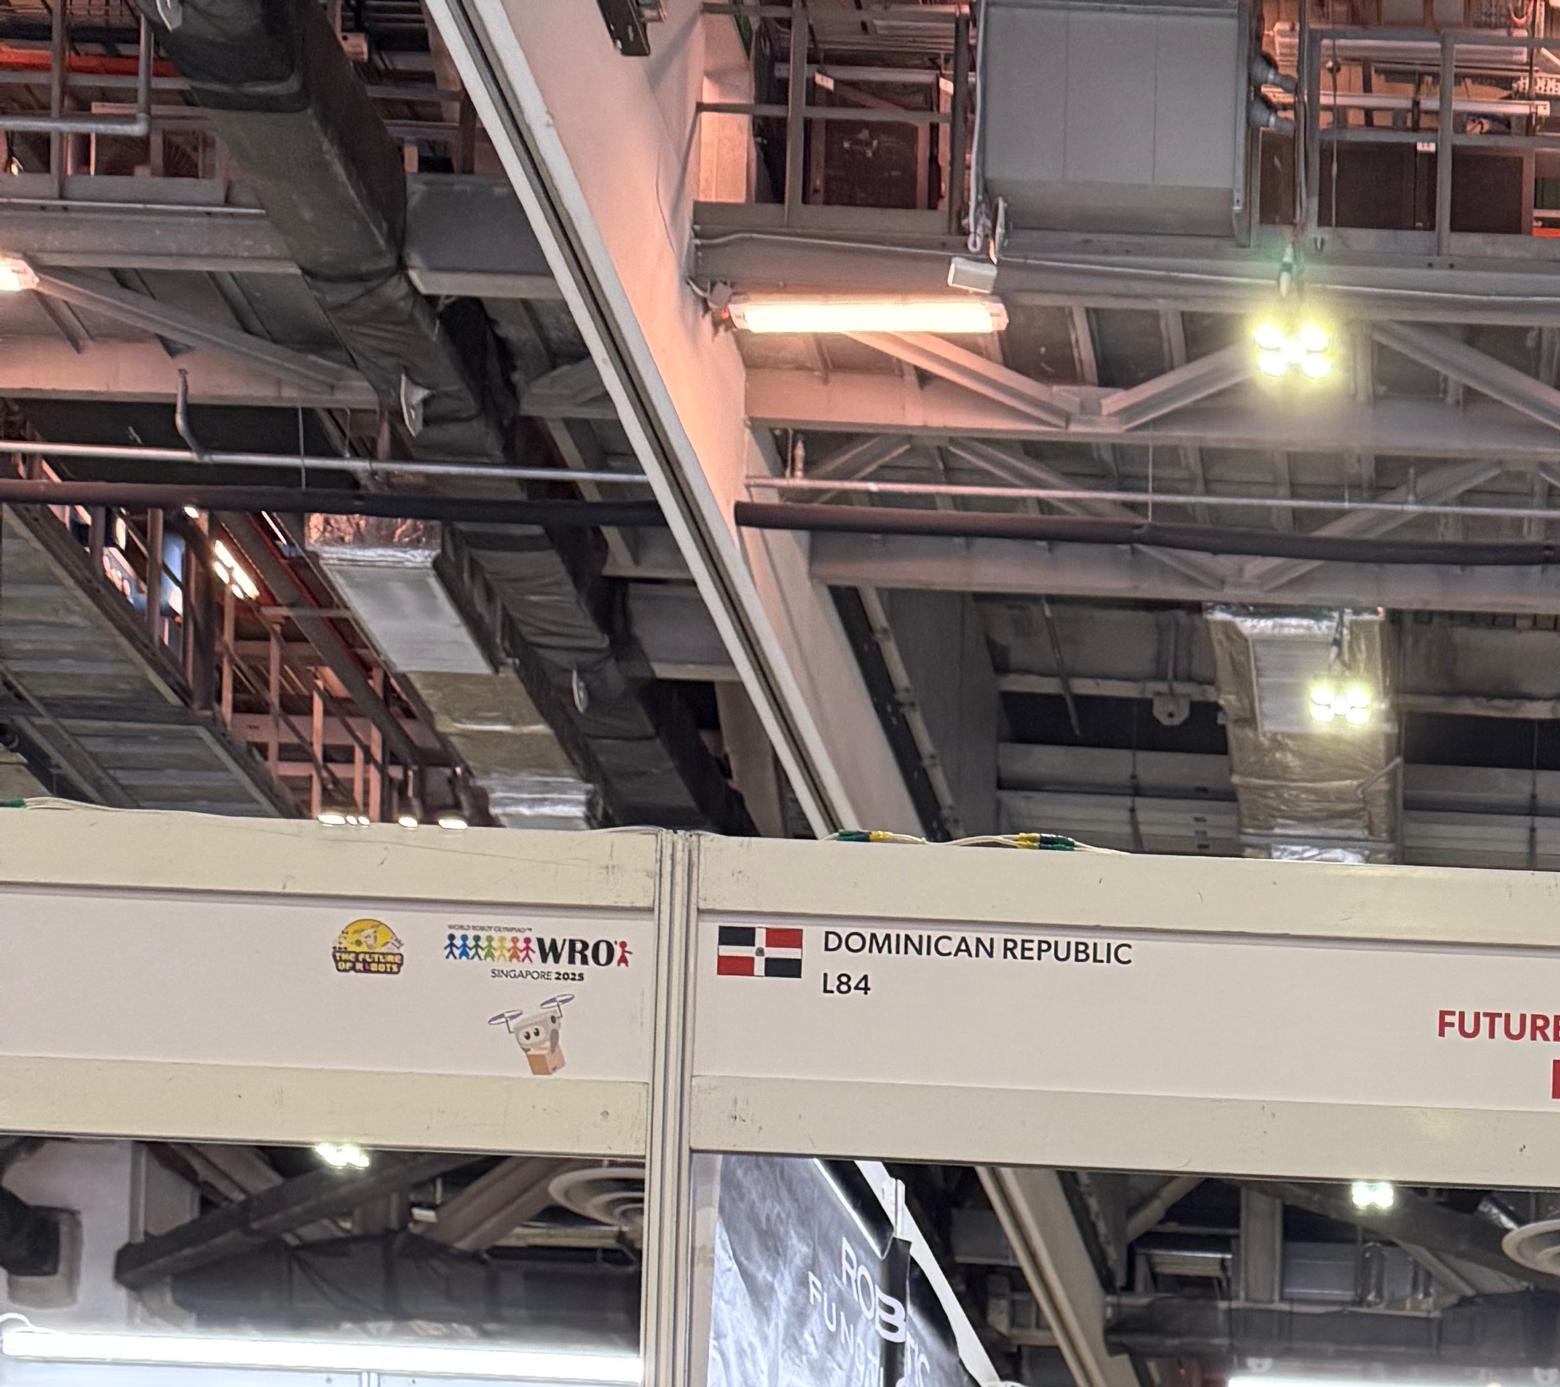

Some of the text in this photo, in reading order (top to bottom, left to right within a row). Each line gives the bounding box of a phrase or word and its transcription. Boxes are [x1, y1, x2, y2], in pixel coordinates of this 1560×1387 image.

[536, 937, 614, 966] WRO
[824, 930, 1133, 965] DOMINICAN REPUBLIC
[491, 968, 585, 982] SINGAPORE 2025
[823, 972, 871, 995] L84
